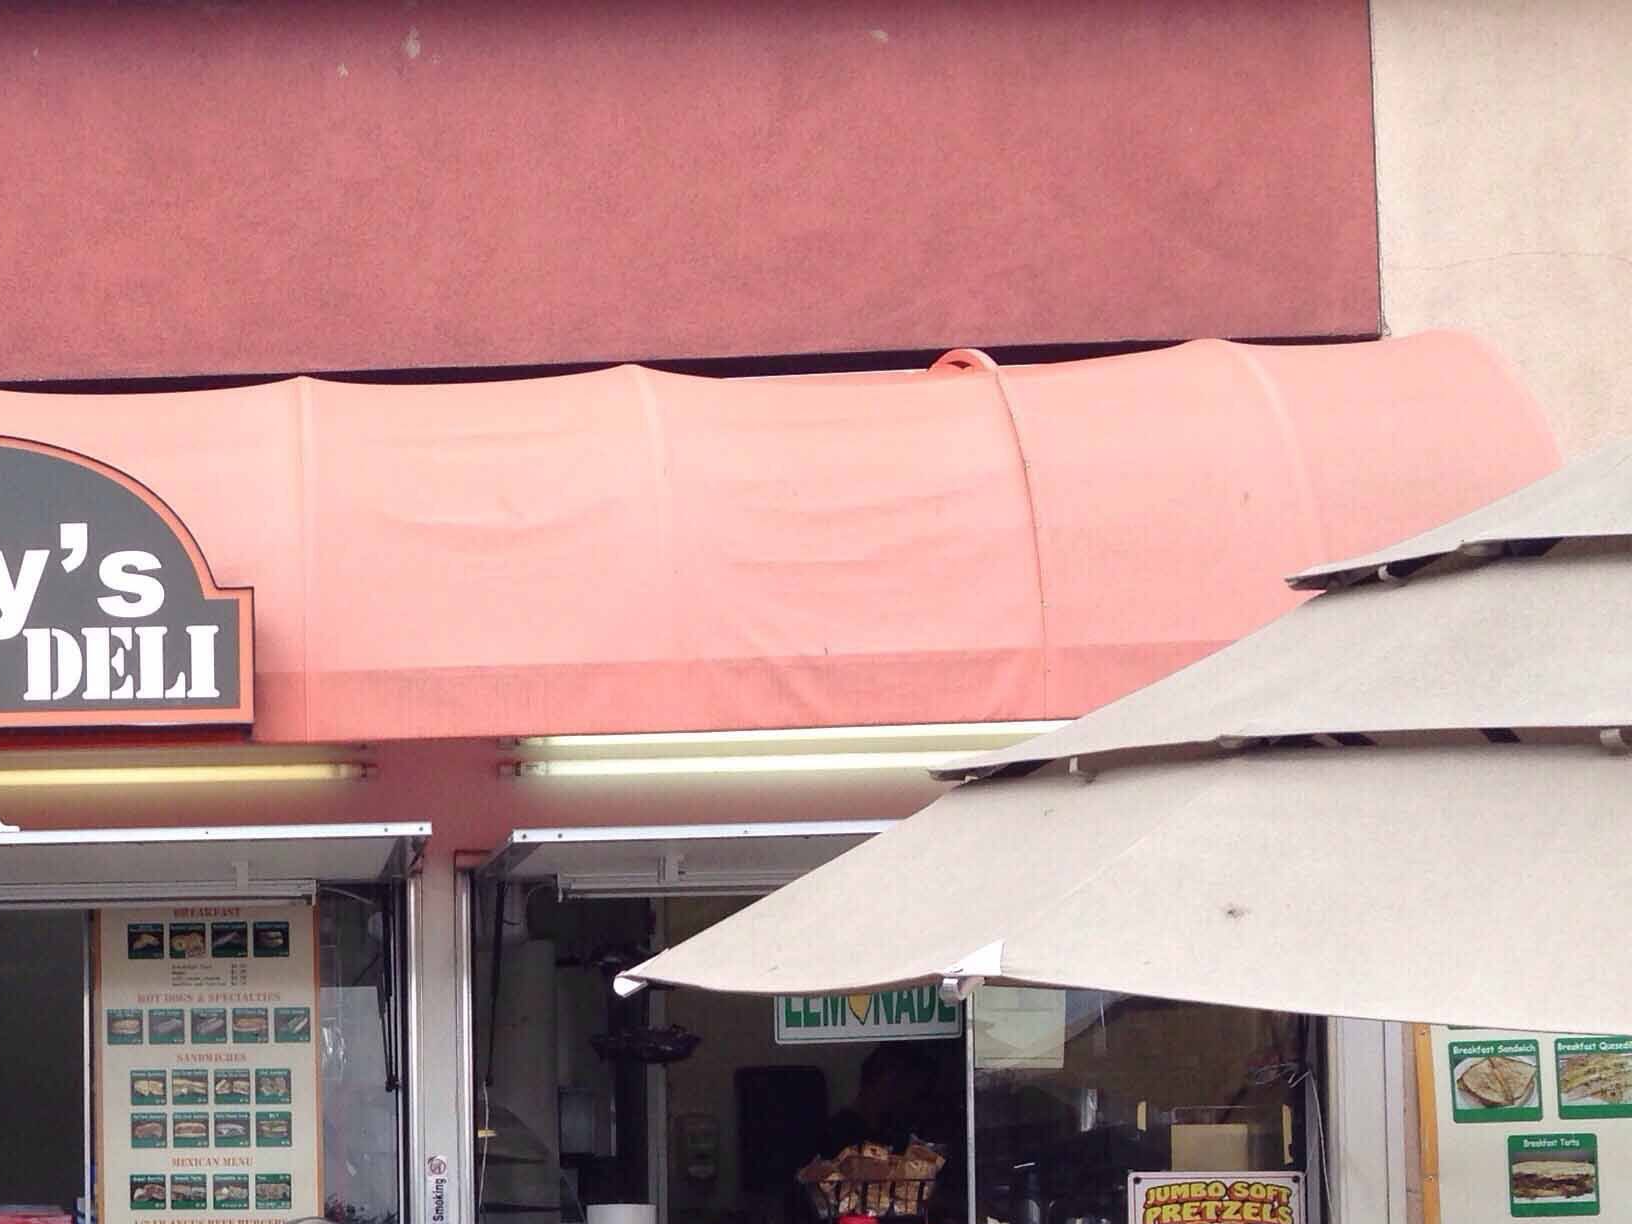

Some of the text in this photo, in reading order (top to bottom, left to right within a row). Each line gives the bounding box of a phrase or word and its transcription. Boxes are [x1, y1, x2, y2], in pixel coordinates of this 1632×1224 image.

[22, 624, 221, 702] DELI
[1453, 1044, 1537, 1055] Breakfast Sandwich
[1557, 1042, 1597, 1051] Breakfast
[1523, 1139, 1558, 1148] Breakfast
[171, 1156, 254, 1167] MEXICAN MENU
[1145, 1181, 1292, 1208] JUMBO SOFT
[432, 1178, 448, 1223] Smoking
